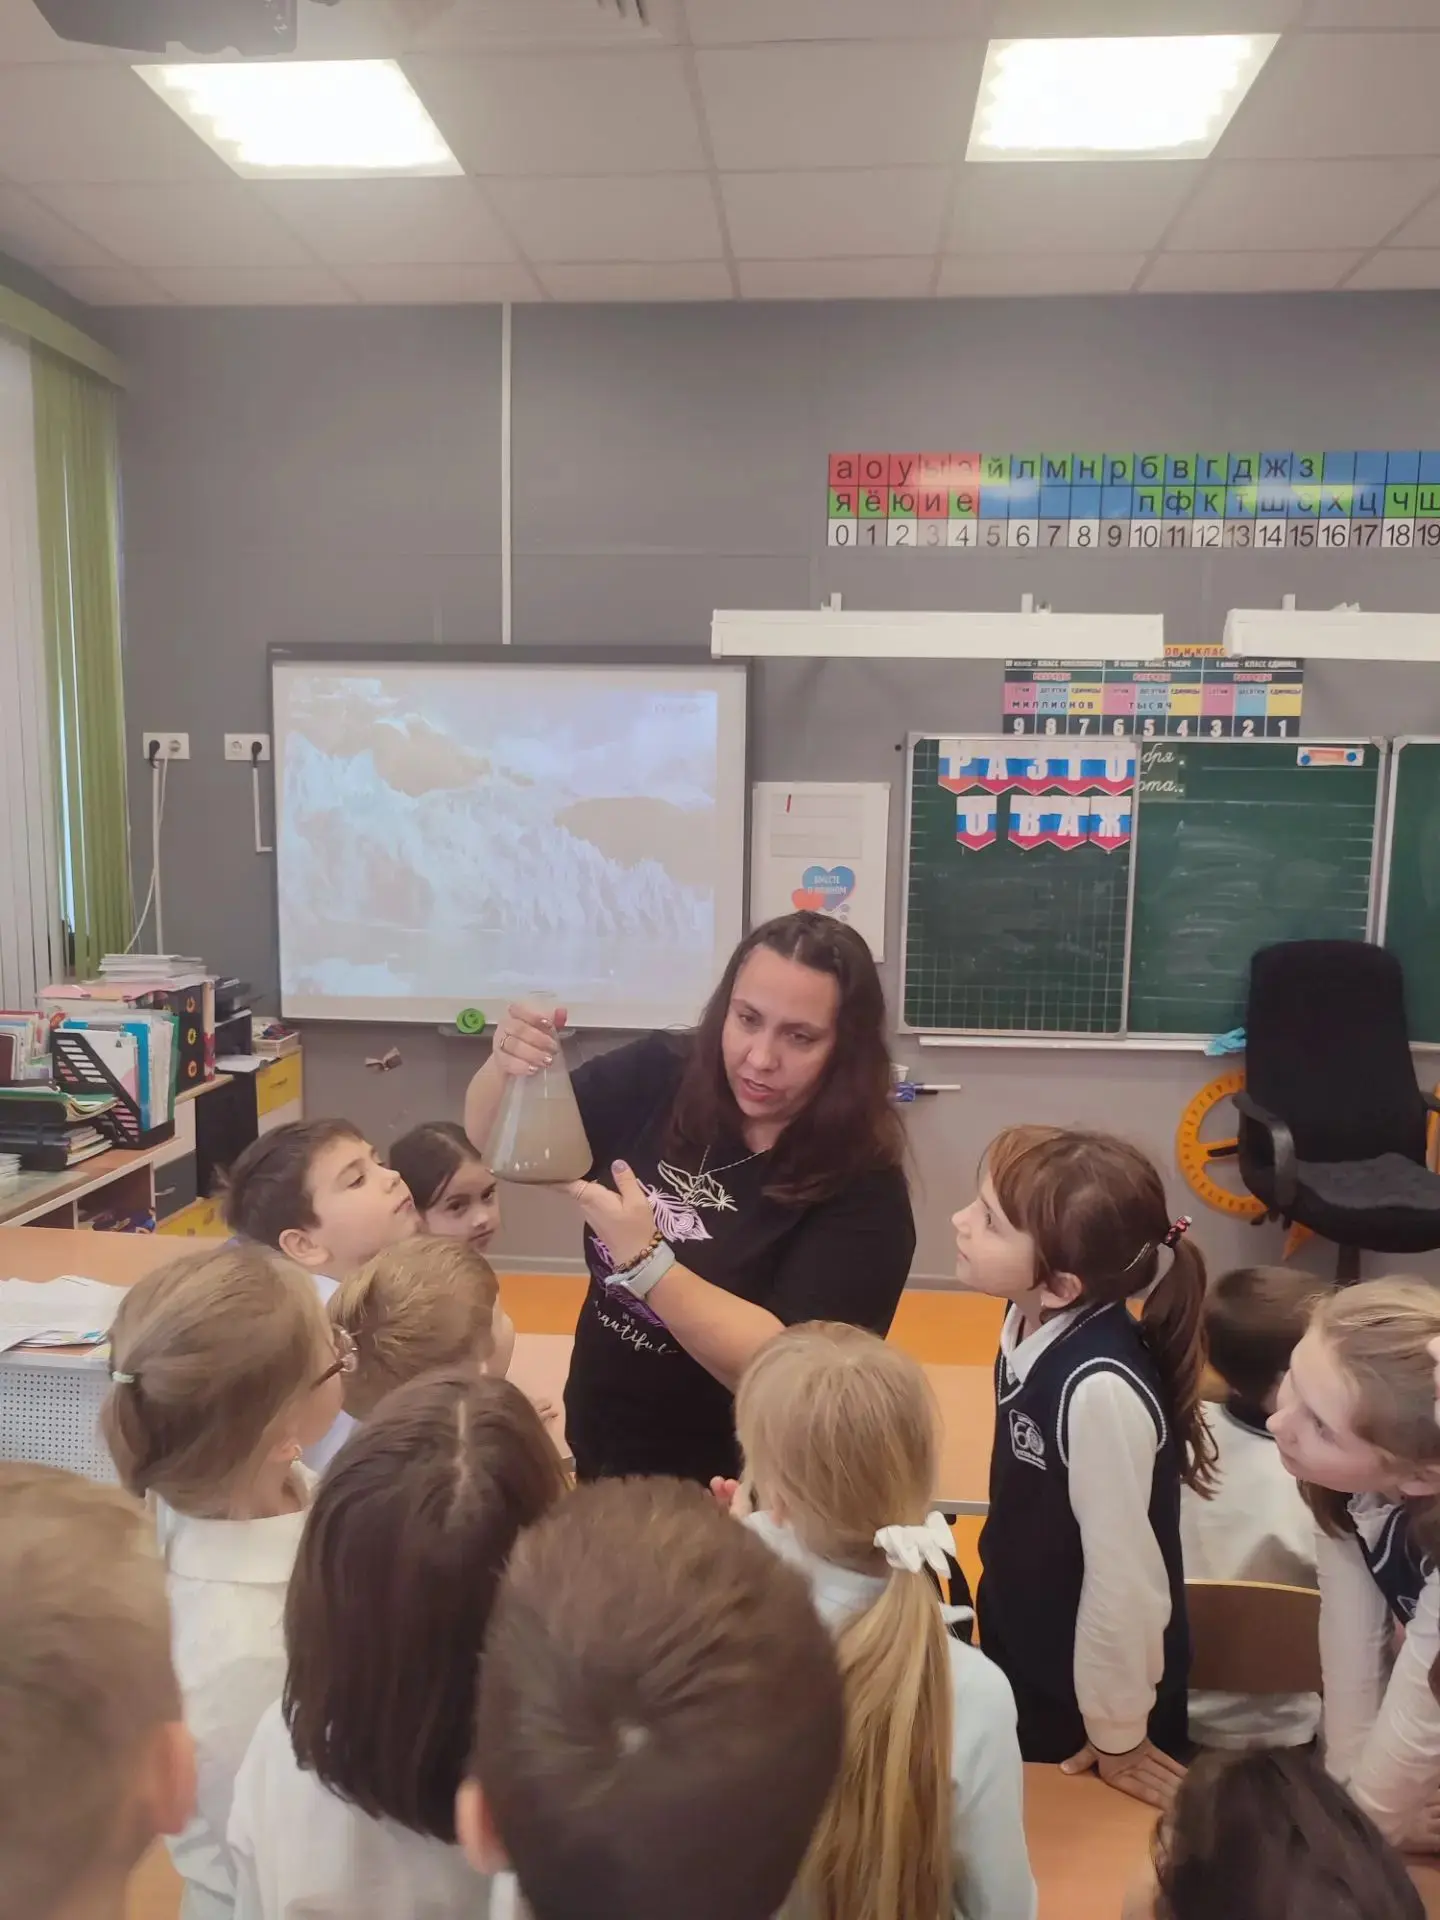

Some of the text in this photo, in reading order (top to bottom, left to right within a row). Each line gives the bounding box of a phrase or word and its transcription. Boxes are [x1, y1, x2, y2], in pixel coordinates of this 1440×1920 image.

[836, 460, 852, 479] а
[866, 460, 882, 479] о
[898, 460, 912, 487] у
[987, 457, 1003, 479] й
[1046, 460, 1067, 479] м
[1080, 460, 1095, 479] н
[1110, 460, 1127, 486] р
[1140, 456, 1160, 478] б
[1173, 460, 1188, 478] в
[1206, 460, 1218, 478] г
[1232, 459, 1252, 482] д
[1264, 458, 1288, 478] ж
[836, 492, 851, 512] я
[866, 486, 881, 512] ё
[892, 492, 915, 512] ю
[925, 492, 940, 512] и
[956, 492, 973, 512] е
[1140, 495, 1154, 512] п
[1166, 490, 1192, 516] ф
[1204, 494, 1218, 512] к
[1328, 494, 1344, 511] х
[1359, 492, 1377, 516] ц
[1393, 492, 1408, 510] ч
[835, 524, 850, 546] 0
[866, 524, 876, 546] 1
[895, 524, 909, 546] 2
[926, 524, 940, 546] 3
[955, 524, 970, 546] 4
[986, 524, 1000, 546] 5
[1016, 524, 1030, 546] 6
[1047, 524, 1061, 546] 7
[1077, 524, 1091, 546] 8
[1107, 524, 1122, 546] 9
[1134, 524, 1158, 547] 10
[1166, 524, 1186, 547] 11
[1196, 524, 1219, 547] 12
[1227, 524, 1250, 547] 13
[1258, 524, 1282, 547] 14
[1290, 524, 1314, 547] 15
[1321, 524, 1346, 547] 16
[1352, 524, 1378, 547] 17
[1386, 524, 1410, 547] 18
[1014, 718, 1287, 737] 9 8 7 6 5 4 3 2 1
